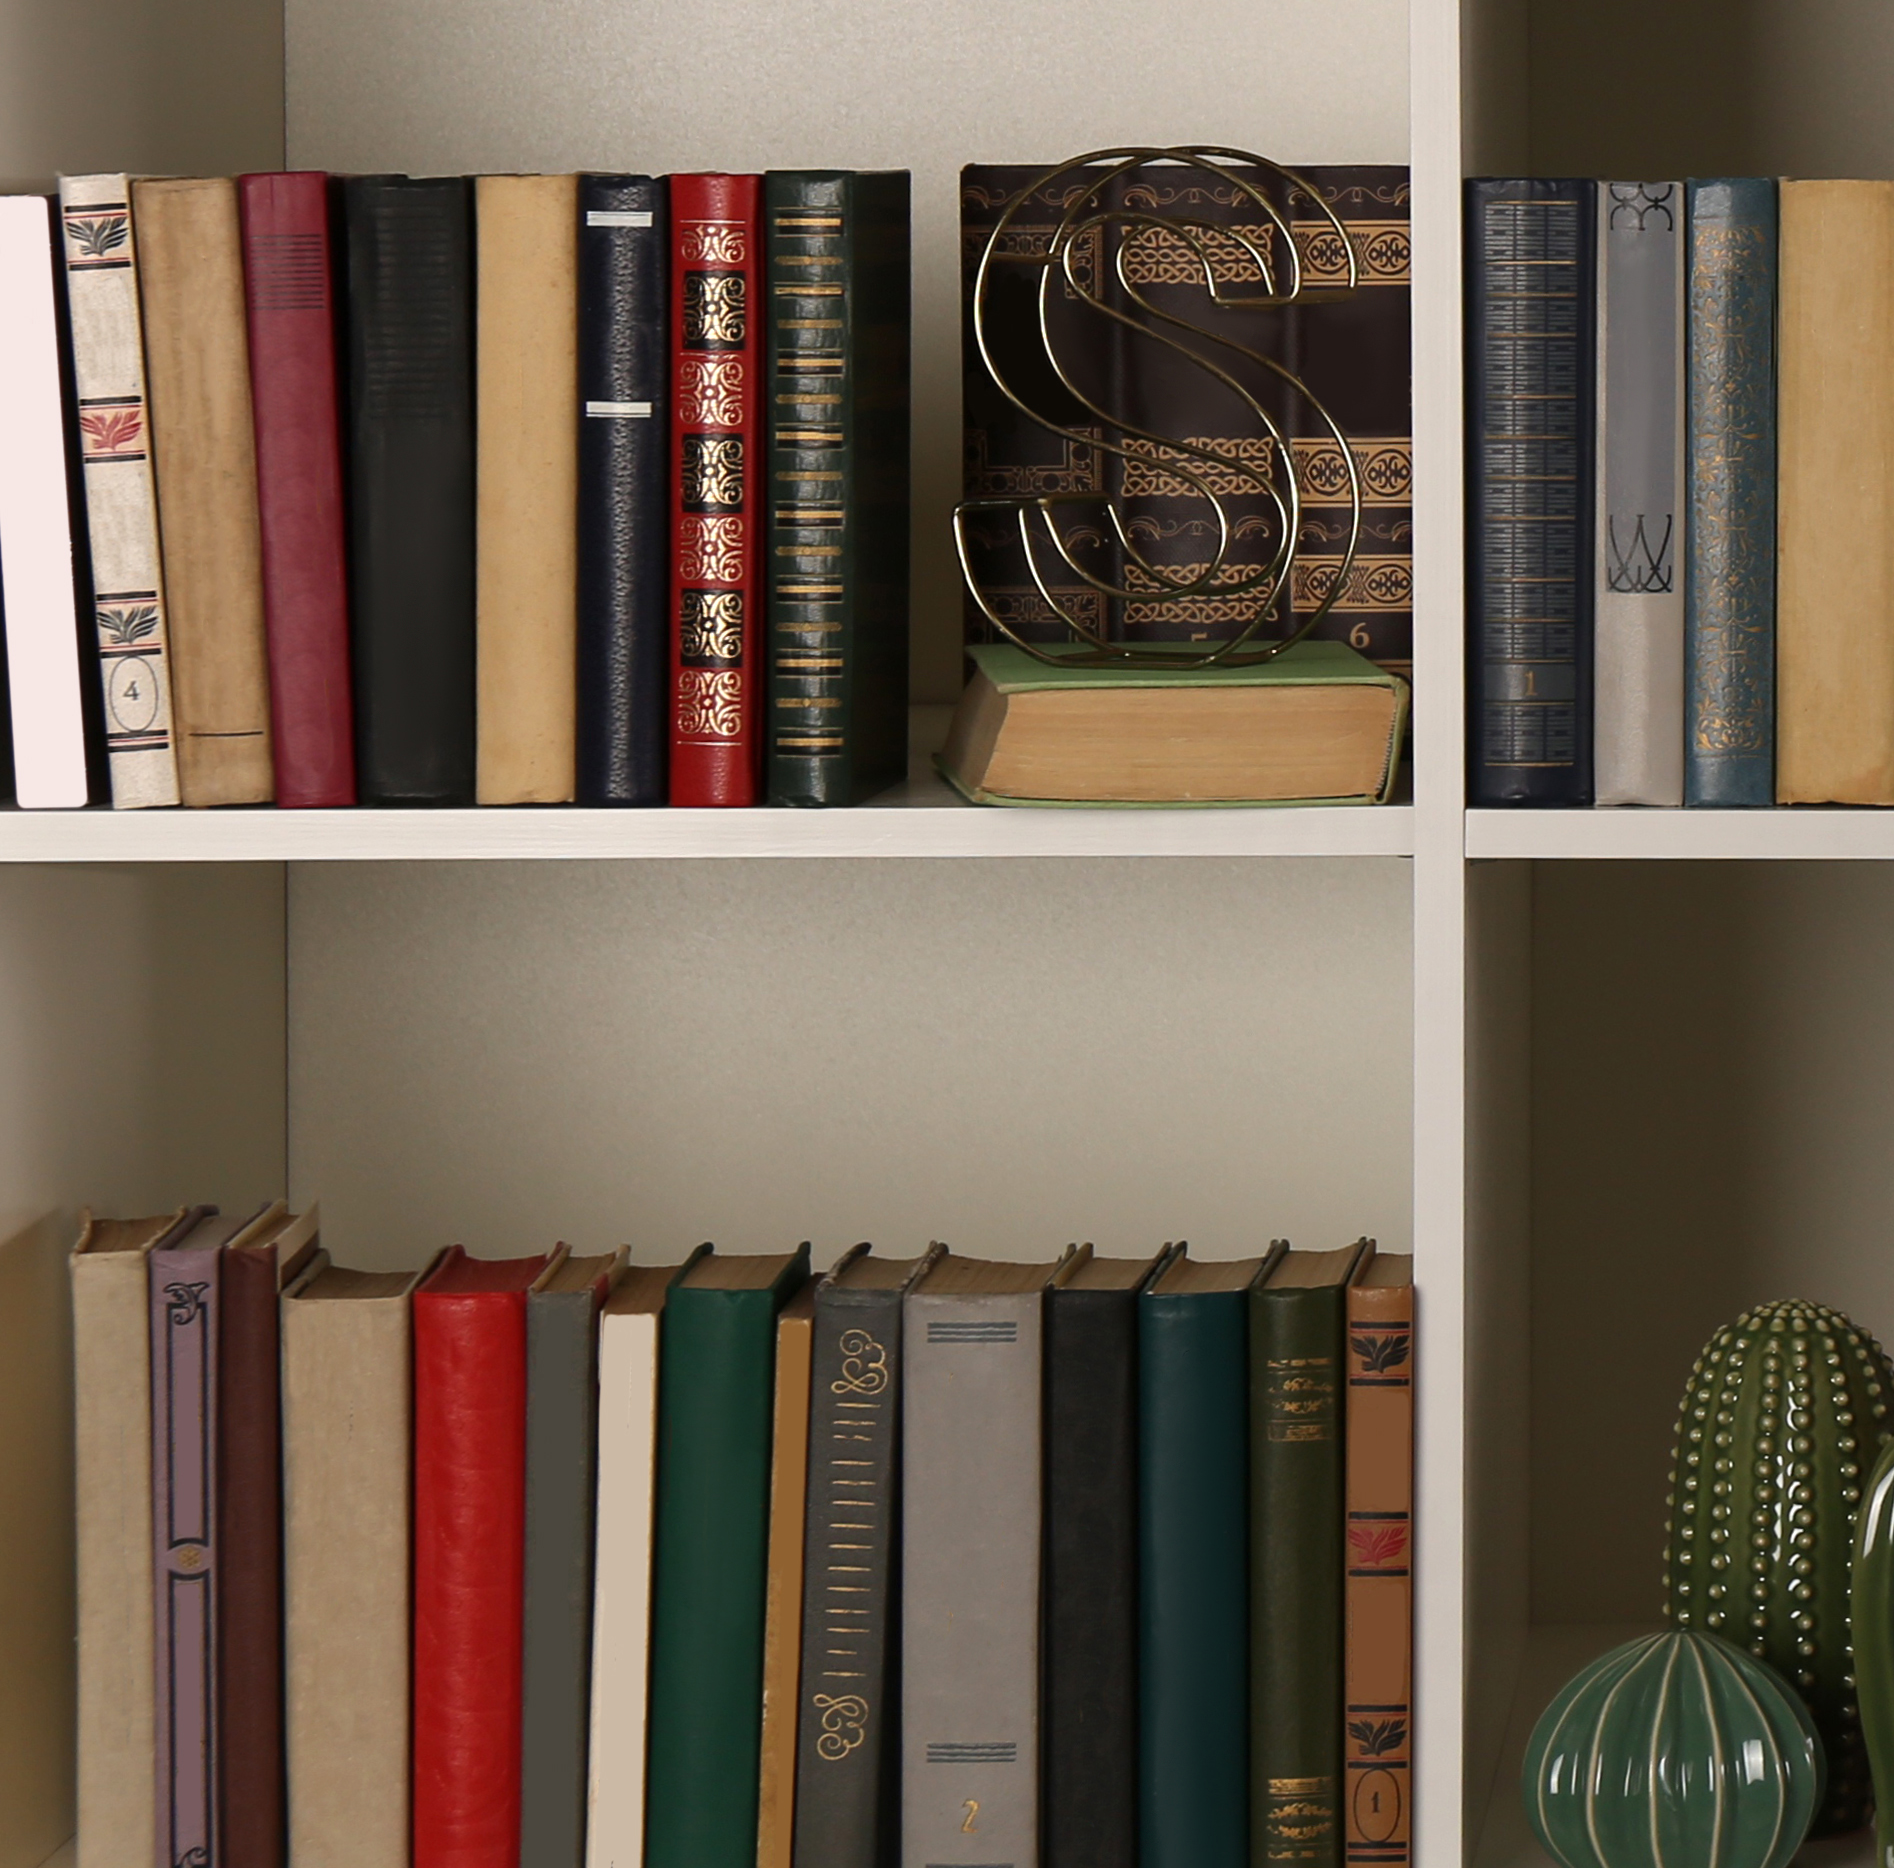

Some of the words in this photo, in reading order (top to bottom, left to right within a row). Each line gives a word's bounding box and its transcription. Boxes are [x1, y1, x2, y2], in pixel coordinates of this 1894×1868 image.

[1350, 622, 1370, 649] 6
[123, 680, 140, 701] 4
[1525, 670, 1537, 696] 1
[1370, 1790, 1381, 1814] 1
[960, 1798, 980, 1834] 2
